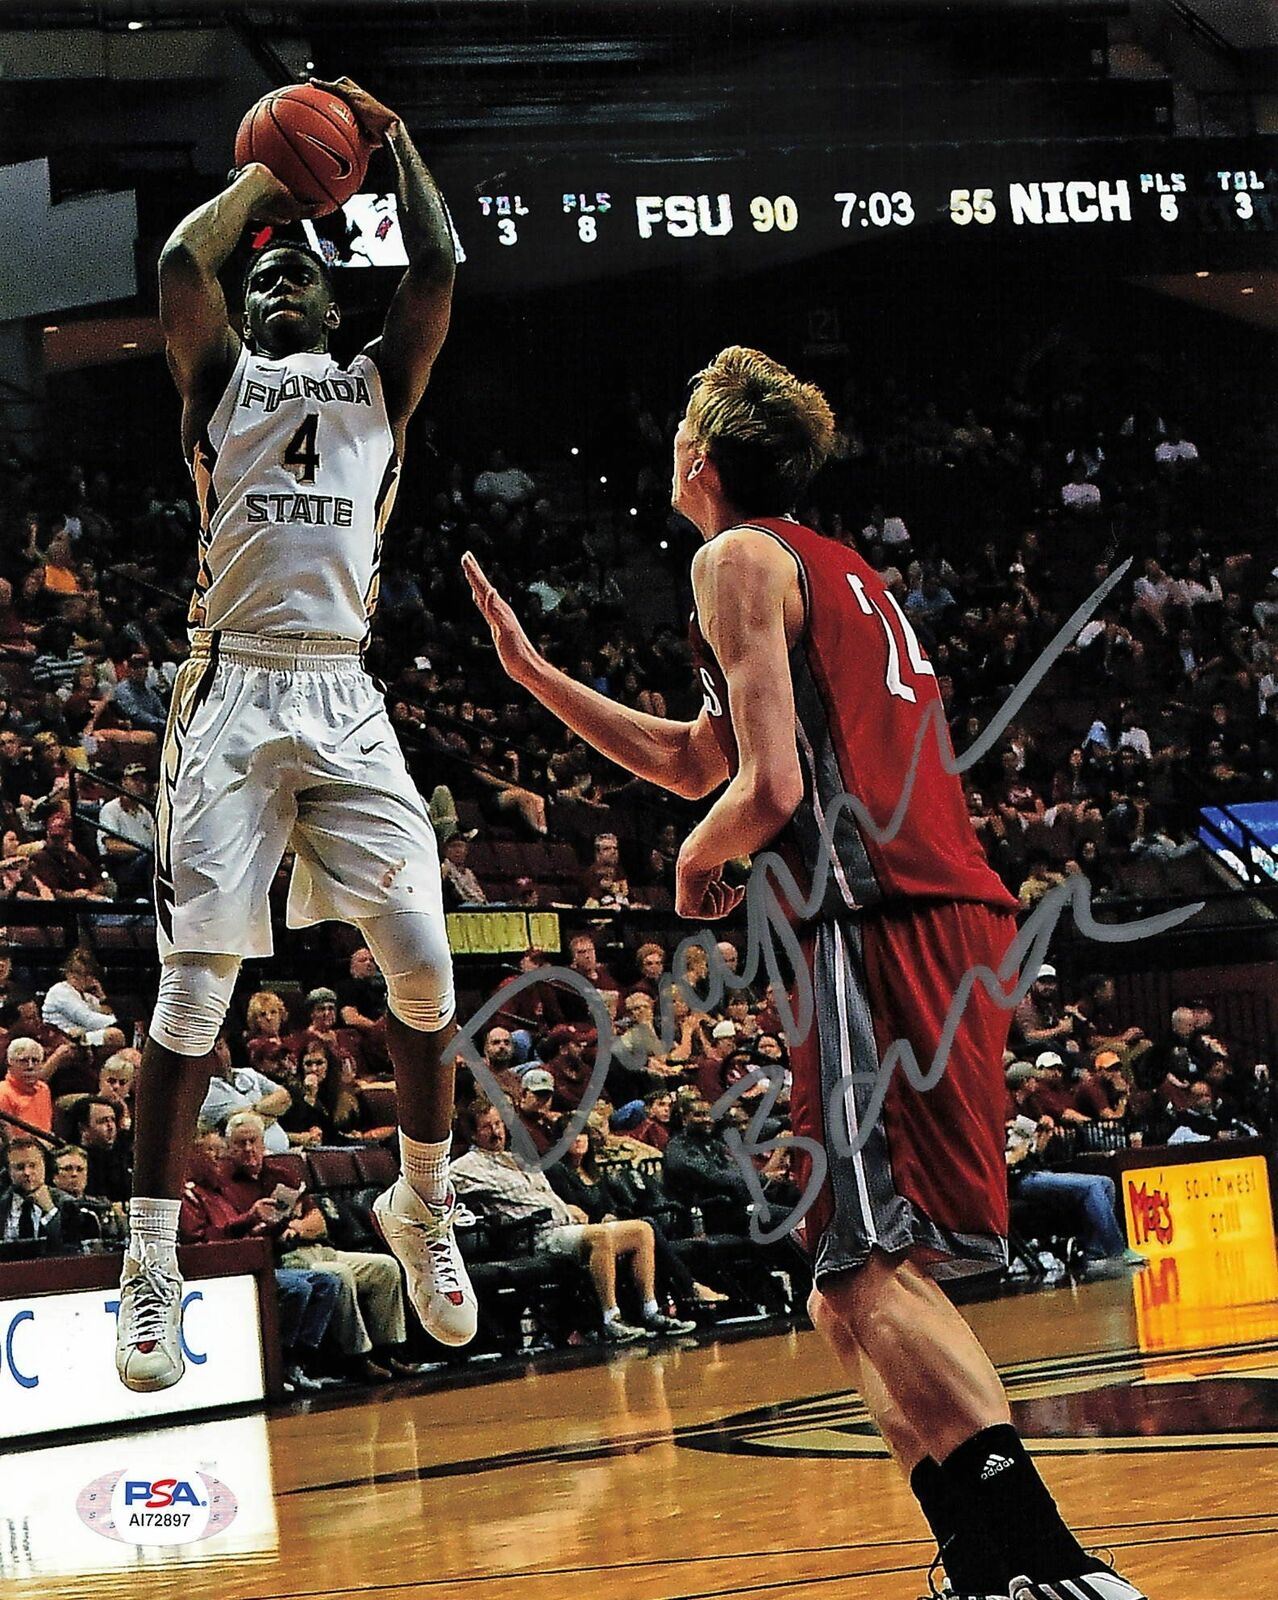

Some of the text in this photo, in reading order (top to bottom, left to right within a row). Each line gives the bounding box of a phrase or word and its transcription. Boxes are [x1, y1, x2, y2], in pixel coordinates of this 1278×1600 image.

[635, 180, 1131, 239] FSU 90 7:03 55 NICH
[1160, 194, 1179, 222] 5
[1235, 192, 1254, 220] 3
[498, 218, 518, 246] 3
[578, 215, 597, 243] 8
[240, 375, 372, 412] FLORIDA
[282, 413, 321, 486] 4
[244, 493, 354, 527] STATE
[980, 1457, 1015, 1480] adidas
